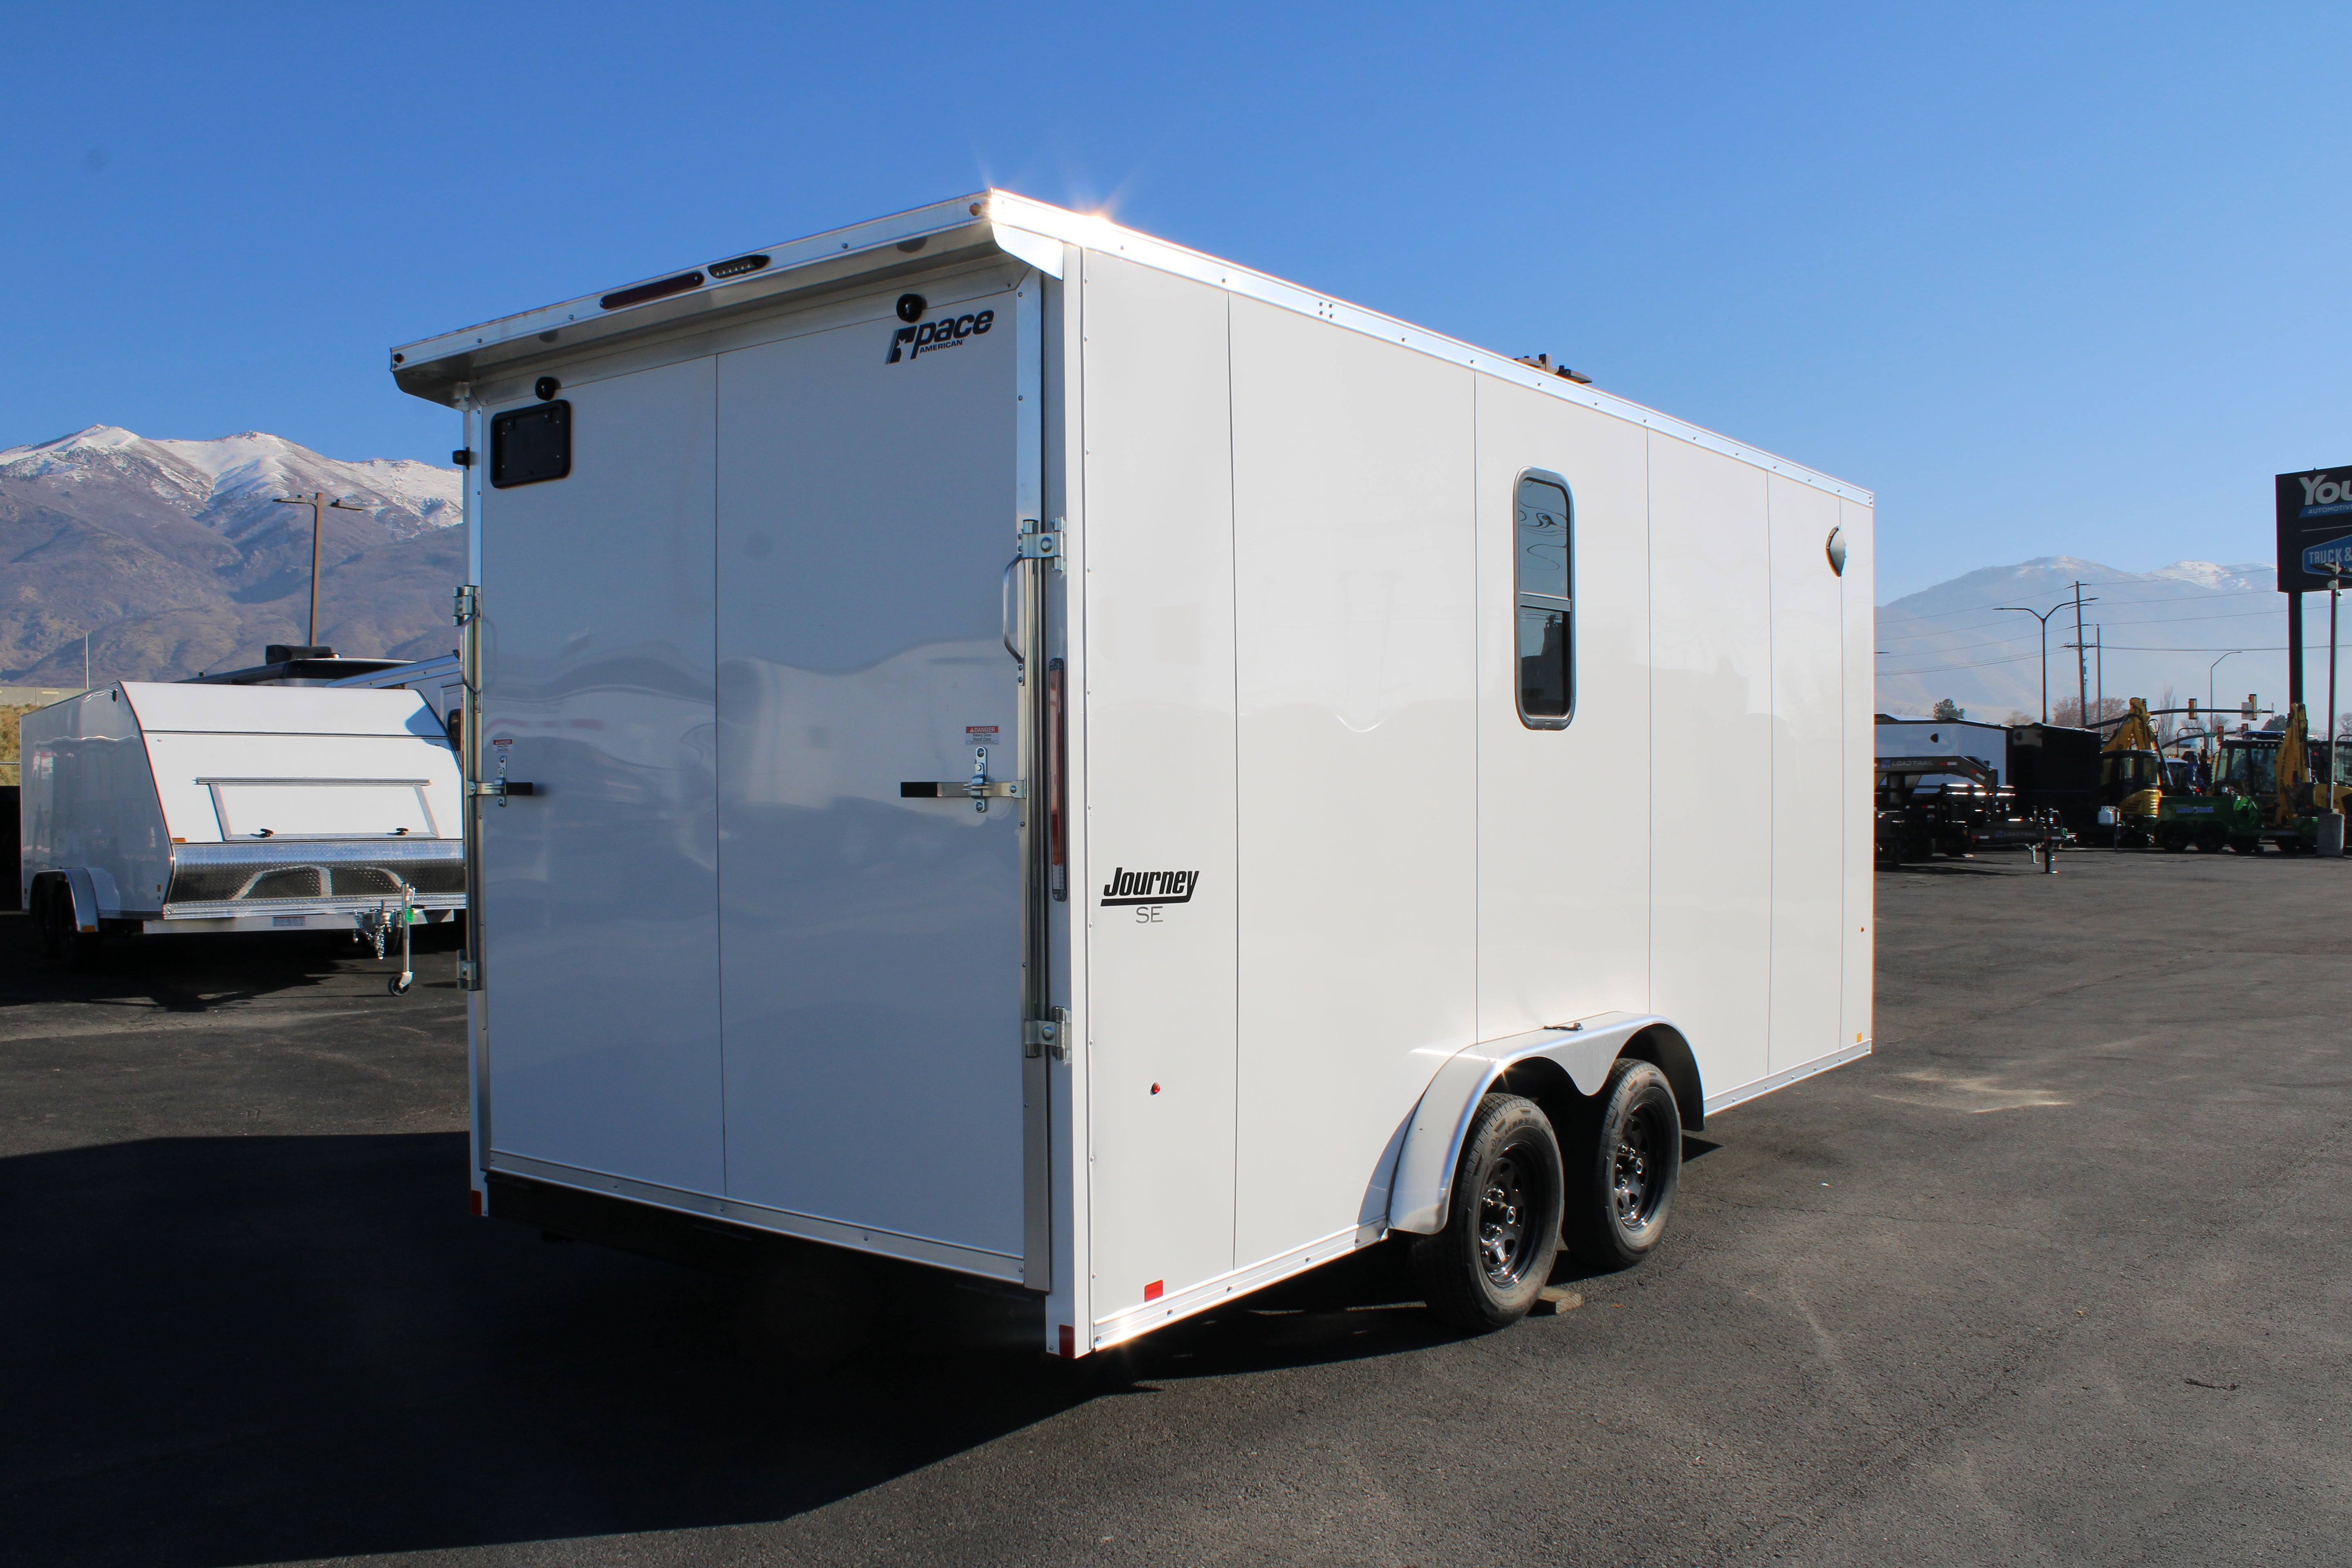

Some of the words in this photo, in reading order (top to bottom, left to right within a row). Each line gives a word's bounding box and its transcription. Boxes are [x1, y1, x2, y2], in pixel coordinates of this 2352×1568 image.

[919, 339, 963, 354] AMERICAN
[2308, 548, 2343, 564] TRUCK
[1102, 867, 1200, 903] Journey
[1136, 906, 1163, 924] SE
